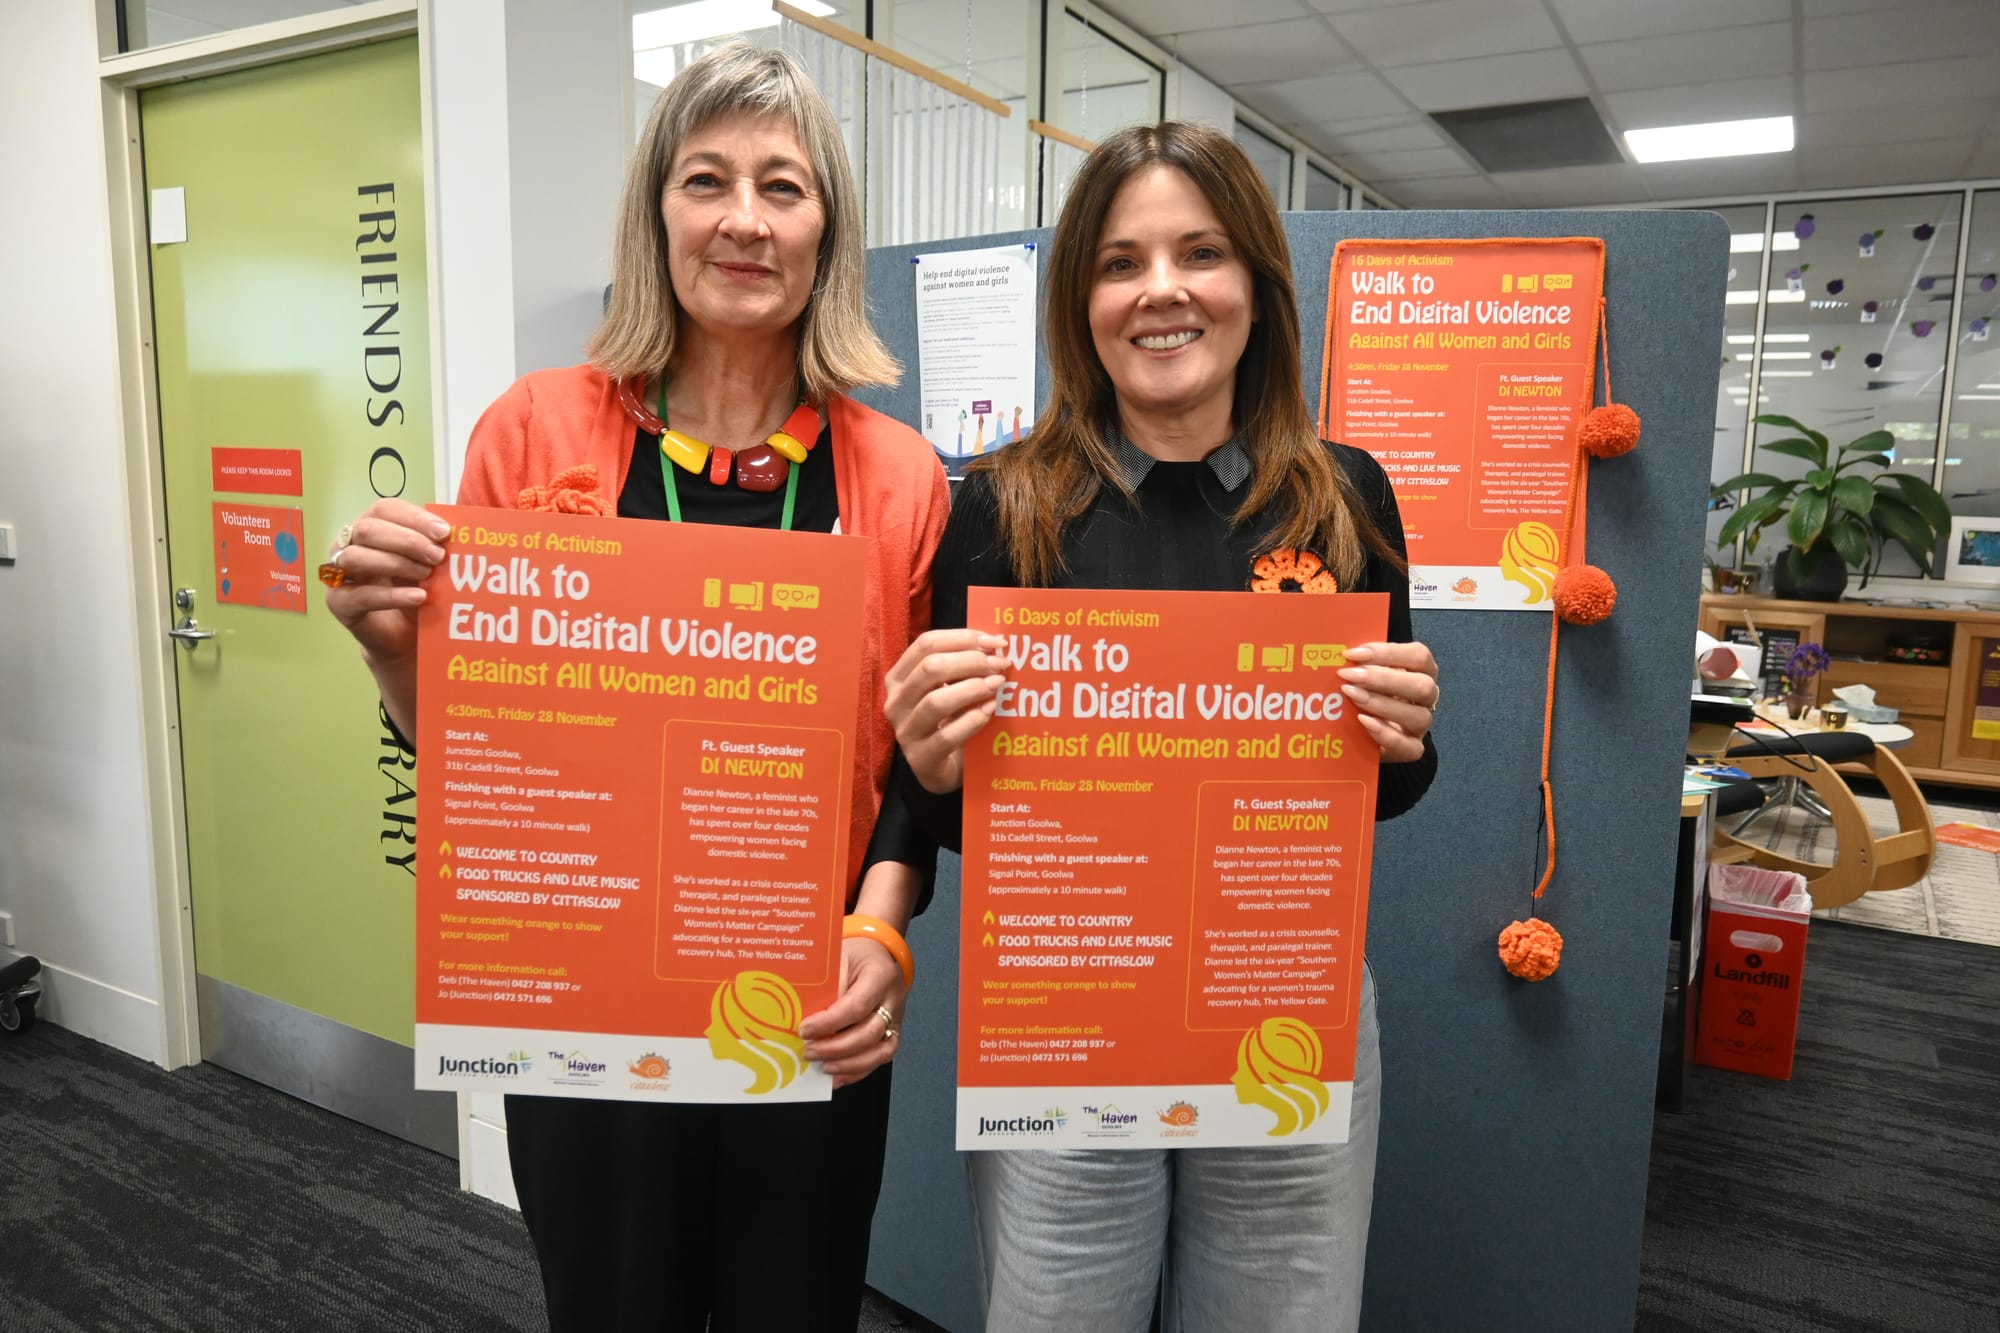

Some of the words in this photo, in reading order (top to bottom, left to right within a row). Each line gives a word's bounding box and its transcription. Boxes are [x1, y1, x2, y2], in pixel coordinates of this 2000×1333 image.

[1350, 254, 1364, 266] 16
[1366, 254, 1392, 266] Days
[1394, 254, 1406, 266] of
[1407, 254, 1453, 266] Activism
[923, 271, 939, 281] Help
[940, 270, 953, 279] end
[954, 267, 978, 279] digital
[979, 265, 1010, 275] violence
[923, 281, 947, 292] against
[948, 280, 975, 289] women
[976, 278, 990, 287] and
[991, 276, 1009, 287] girls
[1351, 270, 1405, 295] Walk
[1411, 272, 1434, 295] to
[355, 182, 405, 427] FRIENDS
[1350, 300, 1392, 324] End
[1398, 300, 1470, 324] Digital
[1475, 300, 1571, 324] Violence
[1348, 332, 1409, 349] Against
[1412, 332, 1434, 349] All
[1438, 332, 1497, 349] Women
[1501, 332, 1530, 349] and
[1534, 332, 1571, 349] Girls
[1499, 374, 1509, 382] Ft.
[1510, 374, 1532, 382] Guest
[1533, 374, 1563, 383] Speaker
[1498, 385, 1510, 396] DI
[1513, 385, 1562, 397] NEWTON
[221, 512, 271, 529] Volunteers
[244, 530, 272, 546] Room
[451, 525, 470, 544] 16
[474, 527, 517, 548] Days
[522, 531, 541, 549] of
[545, 532, 621, 555] Activism
[270, 570, 301, 583] Volunteers
[448, 551, 541, 597] Walk
[551, 564, 589, 600] to
[286, 582, 301, 595] Only
[1414, 584, 1438, 592] Haven
[994, 606, 1014, 625] 16
[1019, 607, 1060, 625] Days
[1065, 607, 1083, 626] of
[1086, 608, 1160, 627] Activism
[448, 602, 519, 644] End
[531, 608, 650, 653] Digital
[660, 617, 817, 665] Violence
[995, 634, 1082, 672] Walk
[1092, 638, 1129, 672] to
[447, 654, 549, 686] Against
[556, 662, 592, 689] All
[599, 664, 696, 696] Women
[704, 674, 750, 700] and
[757, 675, 818, 705] Girls
[995, 681, 1061, 718] End
[1072, 682, 1186, 719] Digital
[1196, 684, 1343, 721] Violence
[701, 739, 717, 751] Ft.
[719, 740, 755, 754] Guest
[756, 743, 805, 757] Speaker
[992, 730, 1089, 757] Against
[1096, 731, 1130, 757] All
[1136, 732, 1229, 758] Women
[1236, 733, 1280, 758] and
[1287, 733, 1343, 759] Girls
[701, 756, 720, 774] DI
[724, 758, 803, 779] NEWTON
[1040, 779, 1076, 791] Friday
[1078, 779, 1093, 792] 28
[1095, 779, 1154, 792] November
[990, 802, 1014, 813] Start
[1015, 803, 1031, 813] At:
[1233, 798, 1248, 809] Ft.
[1250, 798, 1284, 809] Guest
[1285, 798, 1330, 811] Speaker
[989, 818, 1026, 828] Junction
[1027, 818, 1062, 829] Goolwa,
[1232, 815, 1250, 831] DI
[1254, 814, 1328, 831] NEWTON
[990, 833, 1006, 842] 31b
[1007, 833, 1034, 842] Cadell
[1035, 833, 1064, 843] Street,
[1064, 834, 1098, 843] Goolwa
[456, 846, 517, 861] WELCOME
[519, 849, 537, 863] TO
[538, 851, 597, 866] COUNTRY
[989, 852, 1033, 865] Finishing
[1033, 853, 1057, 863] with
[1058, 855, 1065, 863] a
[1066, 854, 1093, 864] guest
[1095, 853, 1134, 864] speaker
[1135, 855, 1148, 863] at:
[456, 867, 490, 880] FOOD
[491, 869, 541, 884] TRUCKS
[543, 872, 570, 885] AND
[571, 874, 598, 888] LIVE
[600, 876, 640, 890] MUSIC
[988, 869, 1014, 880] Signal
[1015, 869, 1040, 879] Point,
[1041, 869, 1074, 879] Goolwa
[456, 887, 531, 904] SPONSORED
[532, 892, 550, 905] BY
[551, 893, 621, 909] CITTASLOW
[988, 884, 1051, 895] (approximately
[1060, 885, 1071, 894] 10
[1072, 886, 1103, 894] minute
[1103, 886, 1127, 896] walk)
[998, 914, 1056, 927] WELCOME
[1058, 914, 1075, 927] TO
[1077, 915, 1133, 927] COUNTRY
[998, 935, 1031, 947] FOOD
[1032, 935, 1079, 947] TRUCKS
[1080, 935, 1106, 947] AND
[1108, 935, 1133, 947] LIVE
[1135, 935, 1173, 947] MUSIC
[998, 955, 1069, 967] SPONSORED
[1070, 955, 1087, 967] BY
[1088, 955, 1155, 967] CITTASLOW
[1714, 963, 1790, 990] Landfill
[980, 1025, 996, 1034] For
[1025, 1025, 1082, 1034] information
[1083, 1025, 1102, 1034] call:
[979, 1039, 997, 1048] Deb
[998, 1040, 1017, 1049] (The
[1019, 1040, 1048, 1048] Haven)
[1049, 1039, 1071, 1048] 0427
[1071, 1039, 1088, 1048] 208
[1088, 1039, 1105, 1048] 937
[548, 1051, 564, 1060] The
[979, 1054, 989, 1062] Jo
[990, 1053, 1031, 1063] (Junction)
[1031, 1053, 1053, 1061] 0472
[1054, 1053, 1070, 1061] 571
[1071, 1052, 1088, 1061] 696
[438, 1055, 518, 1076] Junction
[568, 1060, 606, 1073] Haven
[1082, 1106, 1098, 1115] The
[978, 1116, 1054, 1136] Junction
[1101, 1114, 1137, 1124] Haven
